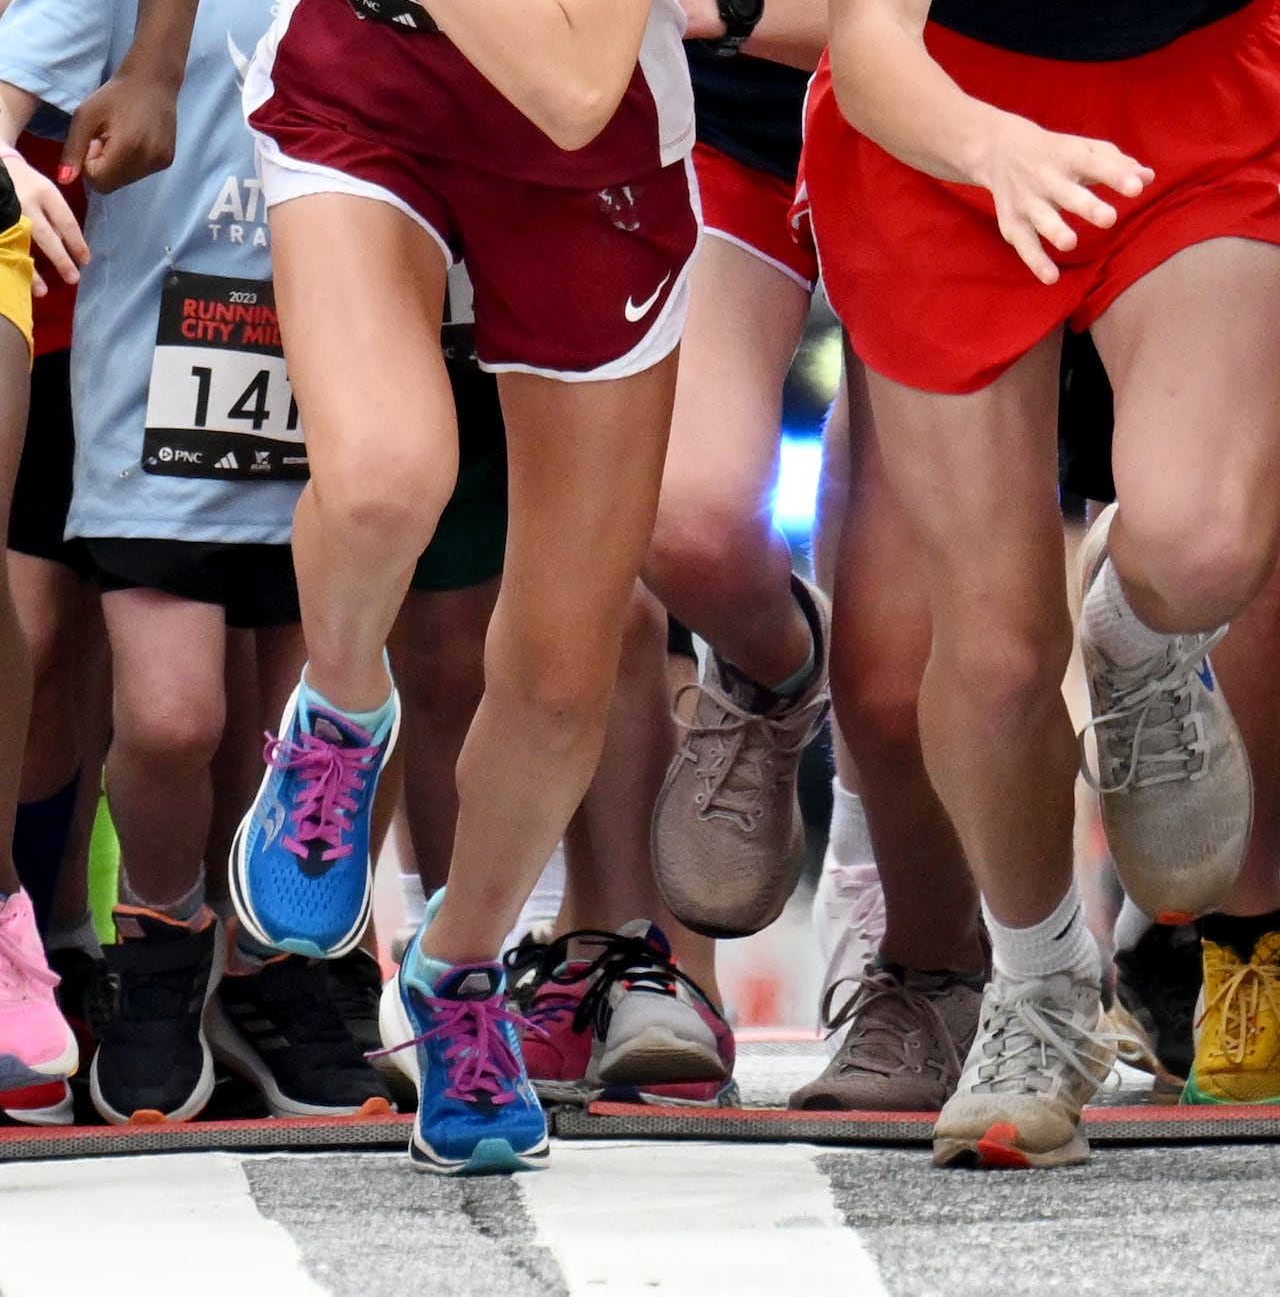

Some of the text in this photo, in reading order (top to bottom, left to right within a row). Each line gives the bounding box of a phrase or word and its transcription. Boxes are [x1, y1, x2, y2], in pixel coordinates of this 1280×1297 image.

[207, 175, 268, 224] AT
[229, 291, 258, 304] 2023
[181, 319, 234, 344] CITY
[174, 449, 203, 464] PNC
